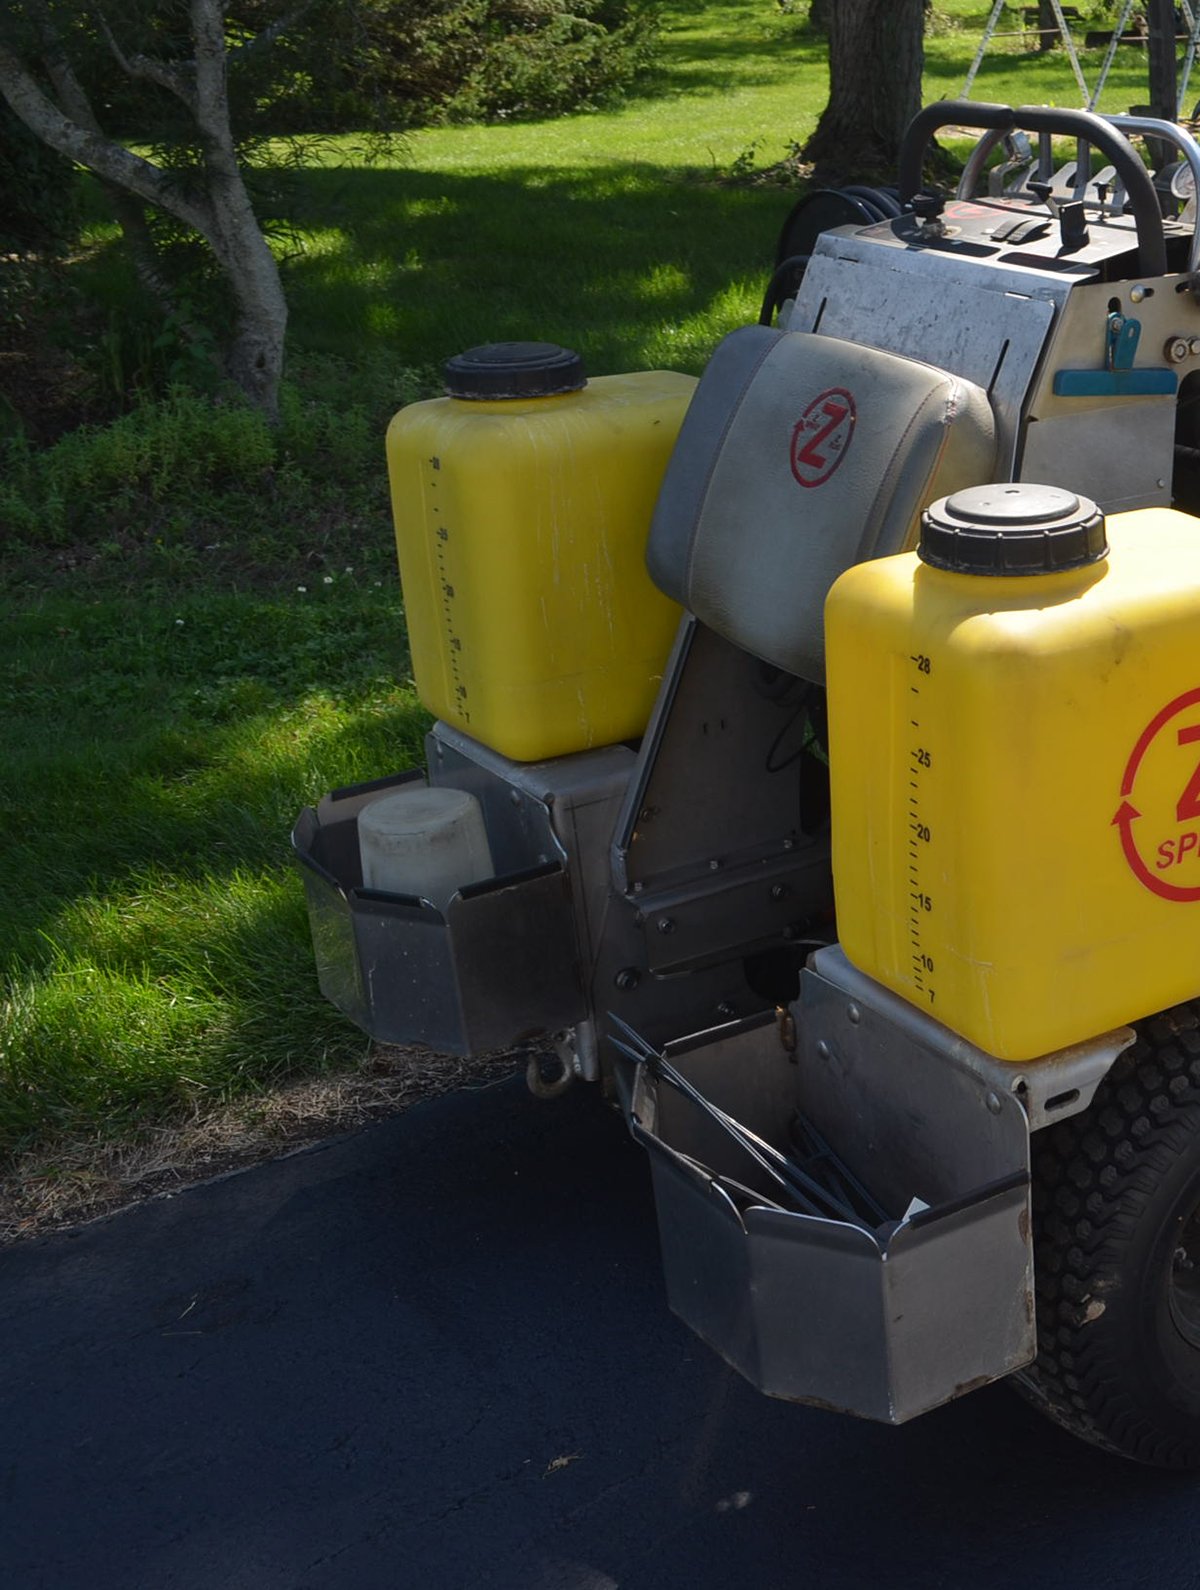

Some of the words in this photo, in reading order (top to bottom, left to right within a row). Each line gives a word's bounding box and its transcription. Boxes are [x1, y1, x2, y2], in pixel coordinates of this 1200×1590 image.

[798, 401, 848, 469] Z
[917, 654, 930, 674] 28
[918, 748, 931, 768] 25
[917, 824, 930, 842] 20
[918, 893, 932, 912] 15
[921, 955, 933, 972] 10
[928, 989, 935, 1002] 7
